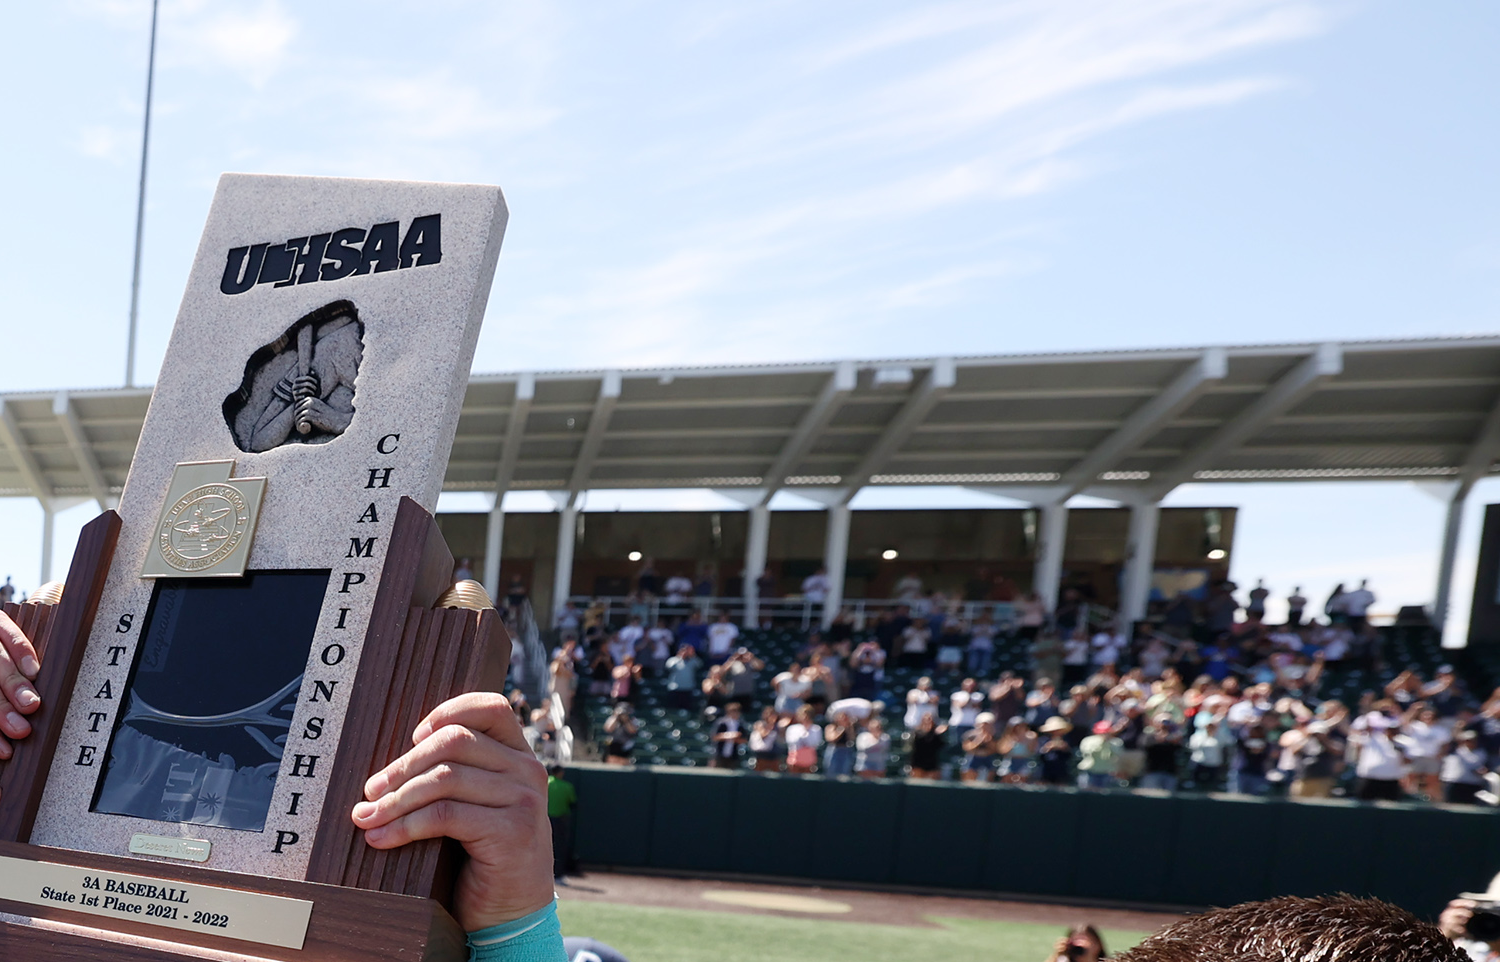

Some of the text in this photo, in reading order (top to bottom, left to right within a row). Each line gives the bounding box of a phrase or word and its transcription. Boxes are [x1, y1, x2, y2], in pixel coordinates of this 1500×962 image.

[219, 212, 443, 295] UHSAA
[271, 432, 401, 854] CHAMPIONSHIP
[74, 613, 134, 767] STATE
[40, 886, 76, 904] State
[79, 892, 100, 908] 1st
[102, 896, 142, 915] Place
[145, 903, 178, 921] 2021
[192, 911, 229, 929] 2022
[82, 876, 190, 904] 3A BASEBALL
